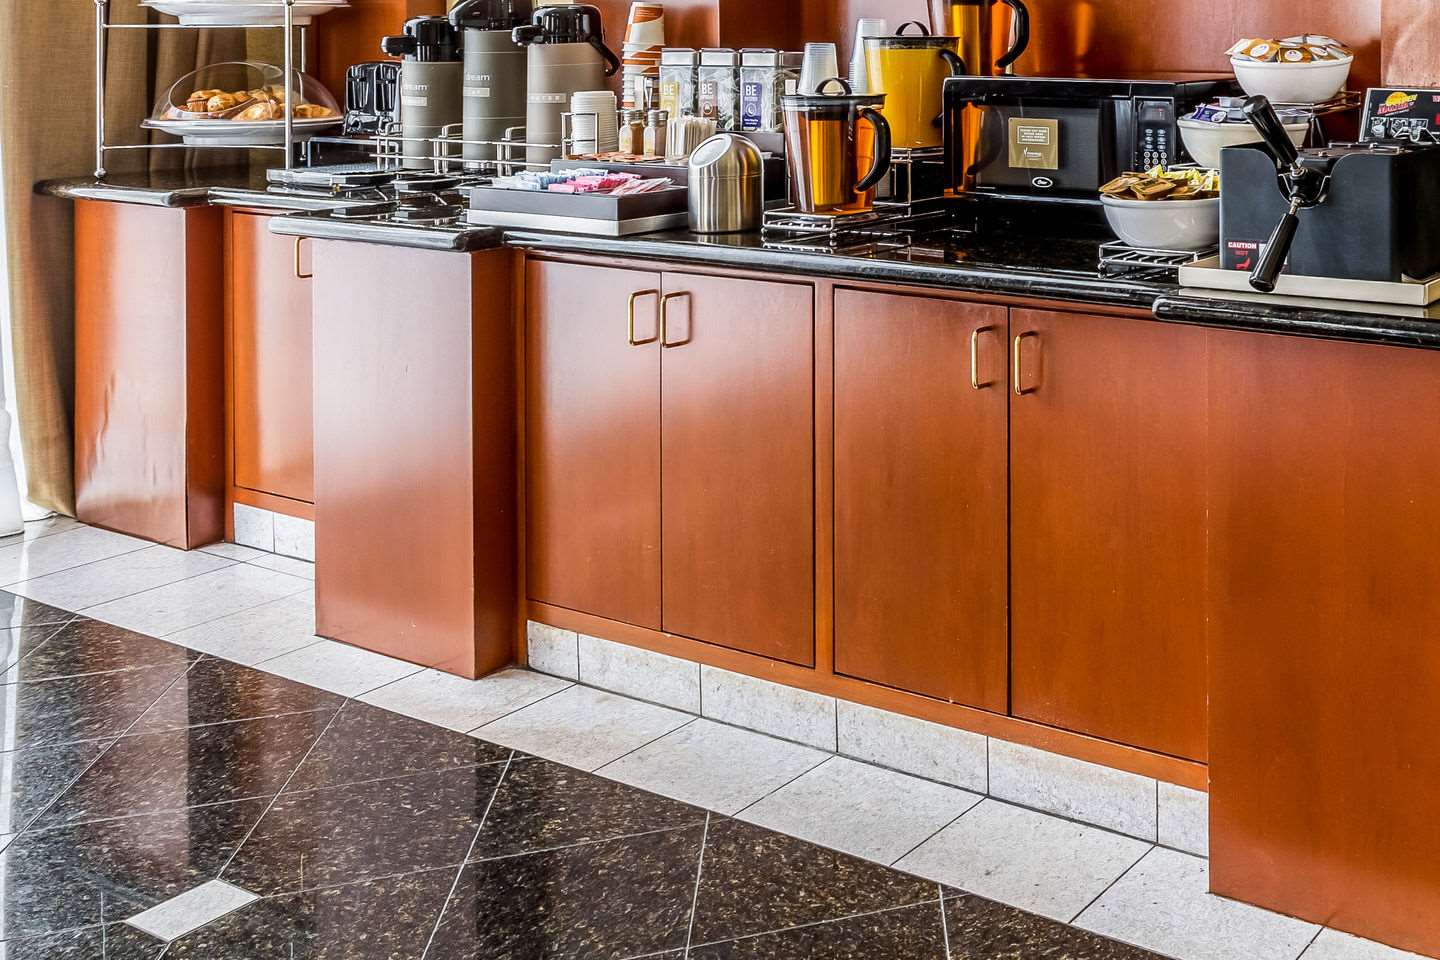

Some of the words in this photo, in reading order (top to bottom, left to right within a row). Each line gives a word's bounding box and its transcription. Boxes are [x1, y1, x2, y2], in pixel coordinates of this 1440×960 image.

[701, 83, 713, 95] BE
[745, 85, 758, 96] BE
[1227, 241, 1257, 249] CAUTION
